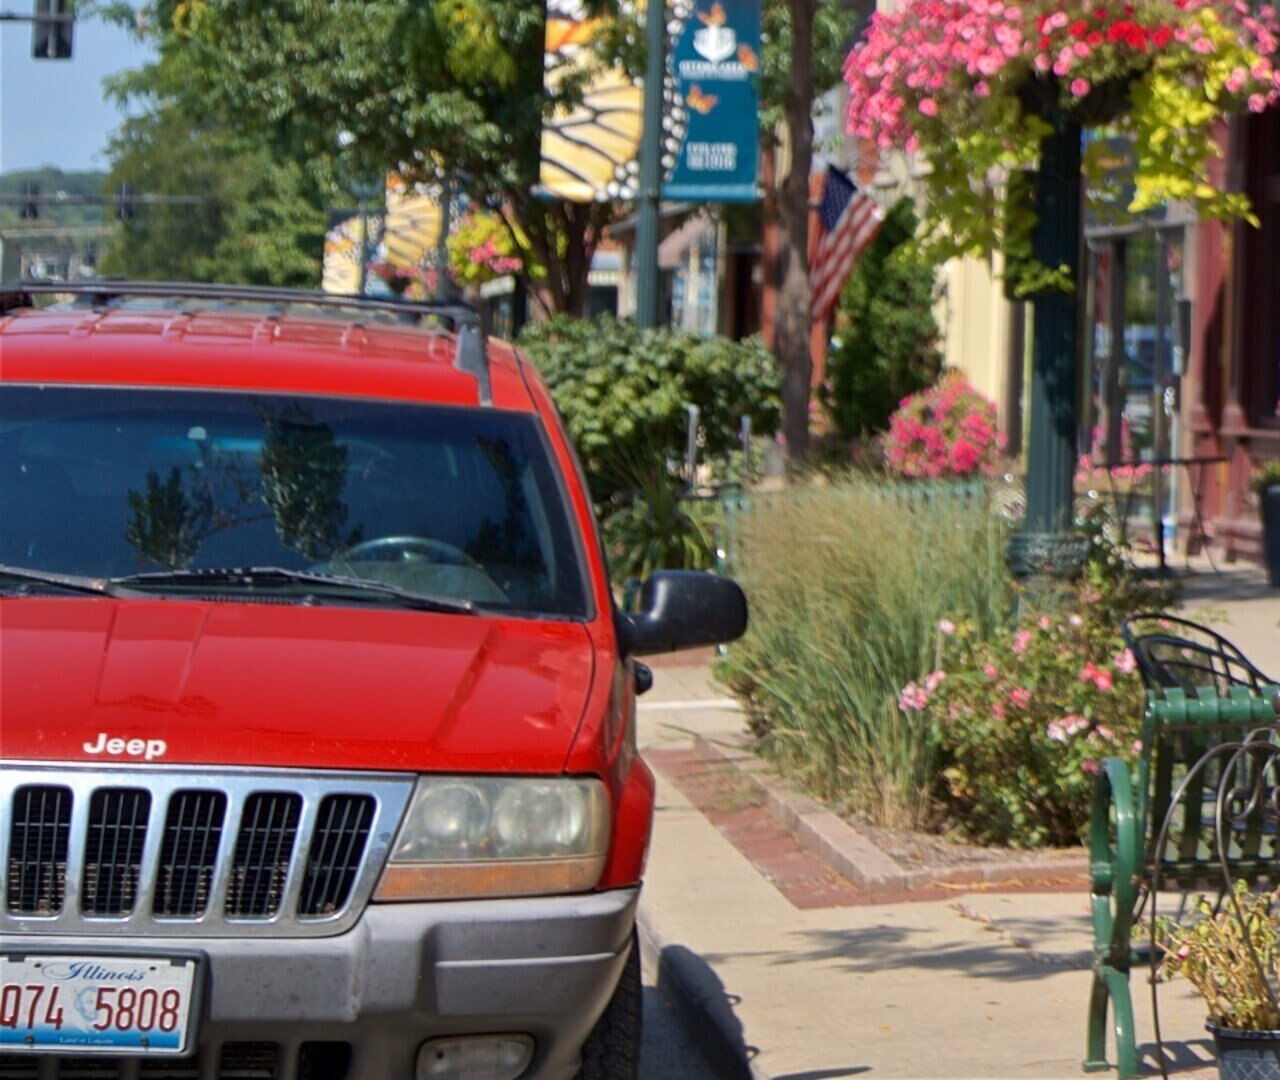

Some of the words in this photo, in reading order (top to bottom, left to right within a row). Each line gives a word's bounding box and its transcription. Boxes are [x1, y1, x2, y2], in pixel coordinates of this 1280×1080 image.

[83, 733, 168, 761] Jeep
[41, 961, 146, 980] Illinois
[93, 986, 181, 1032] 5808
